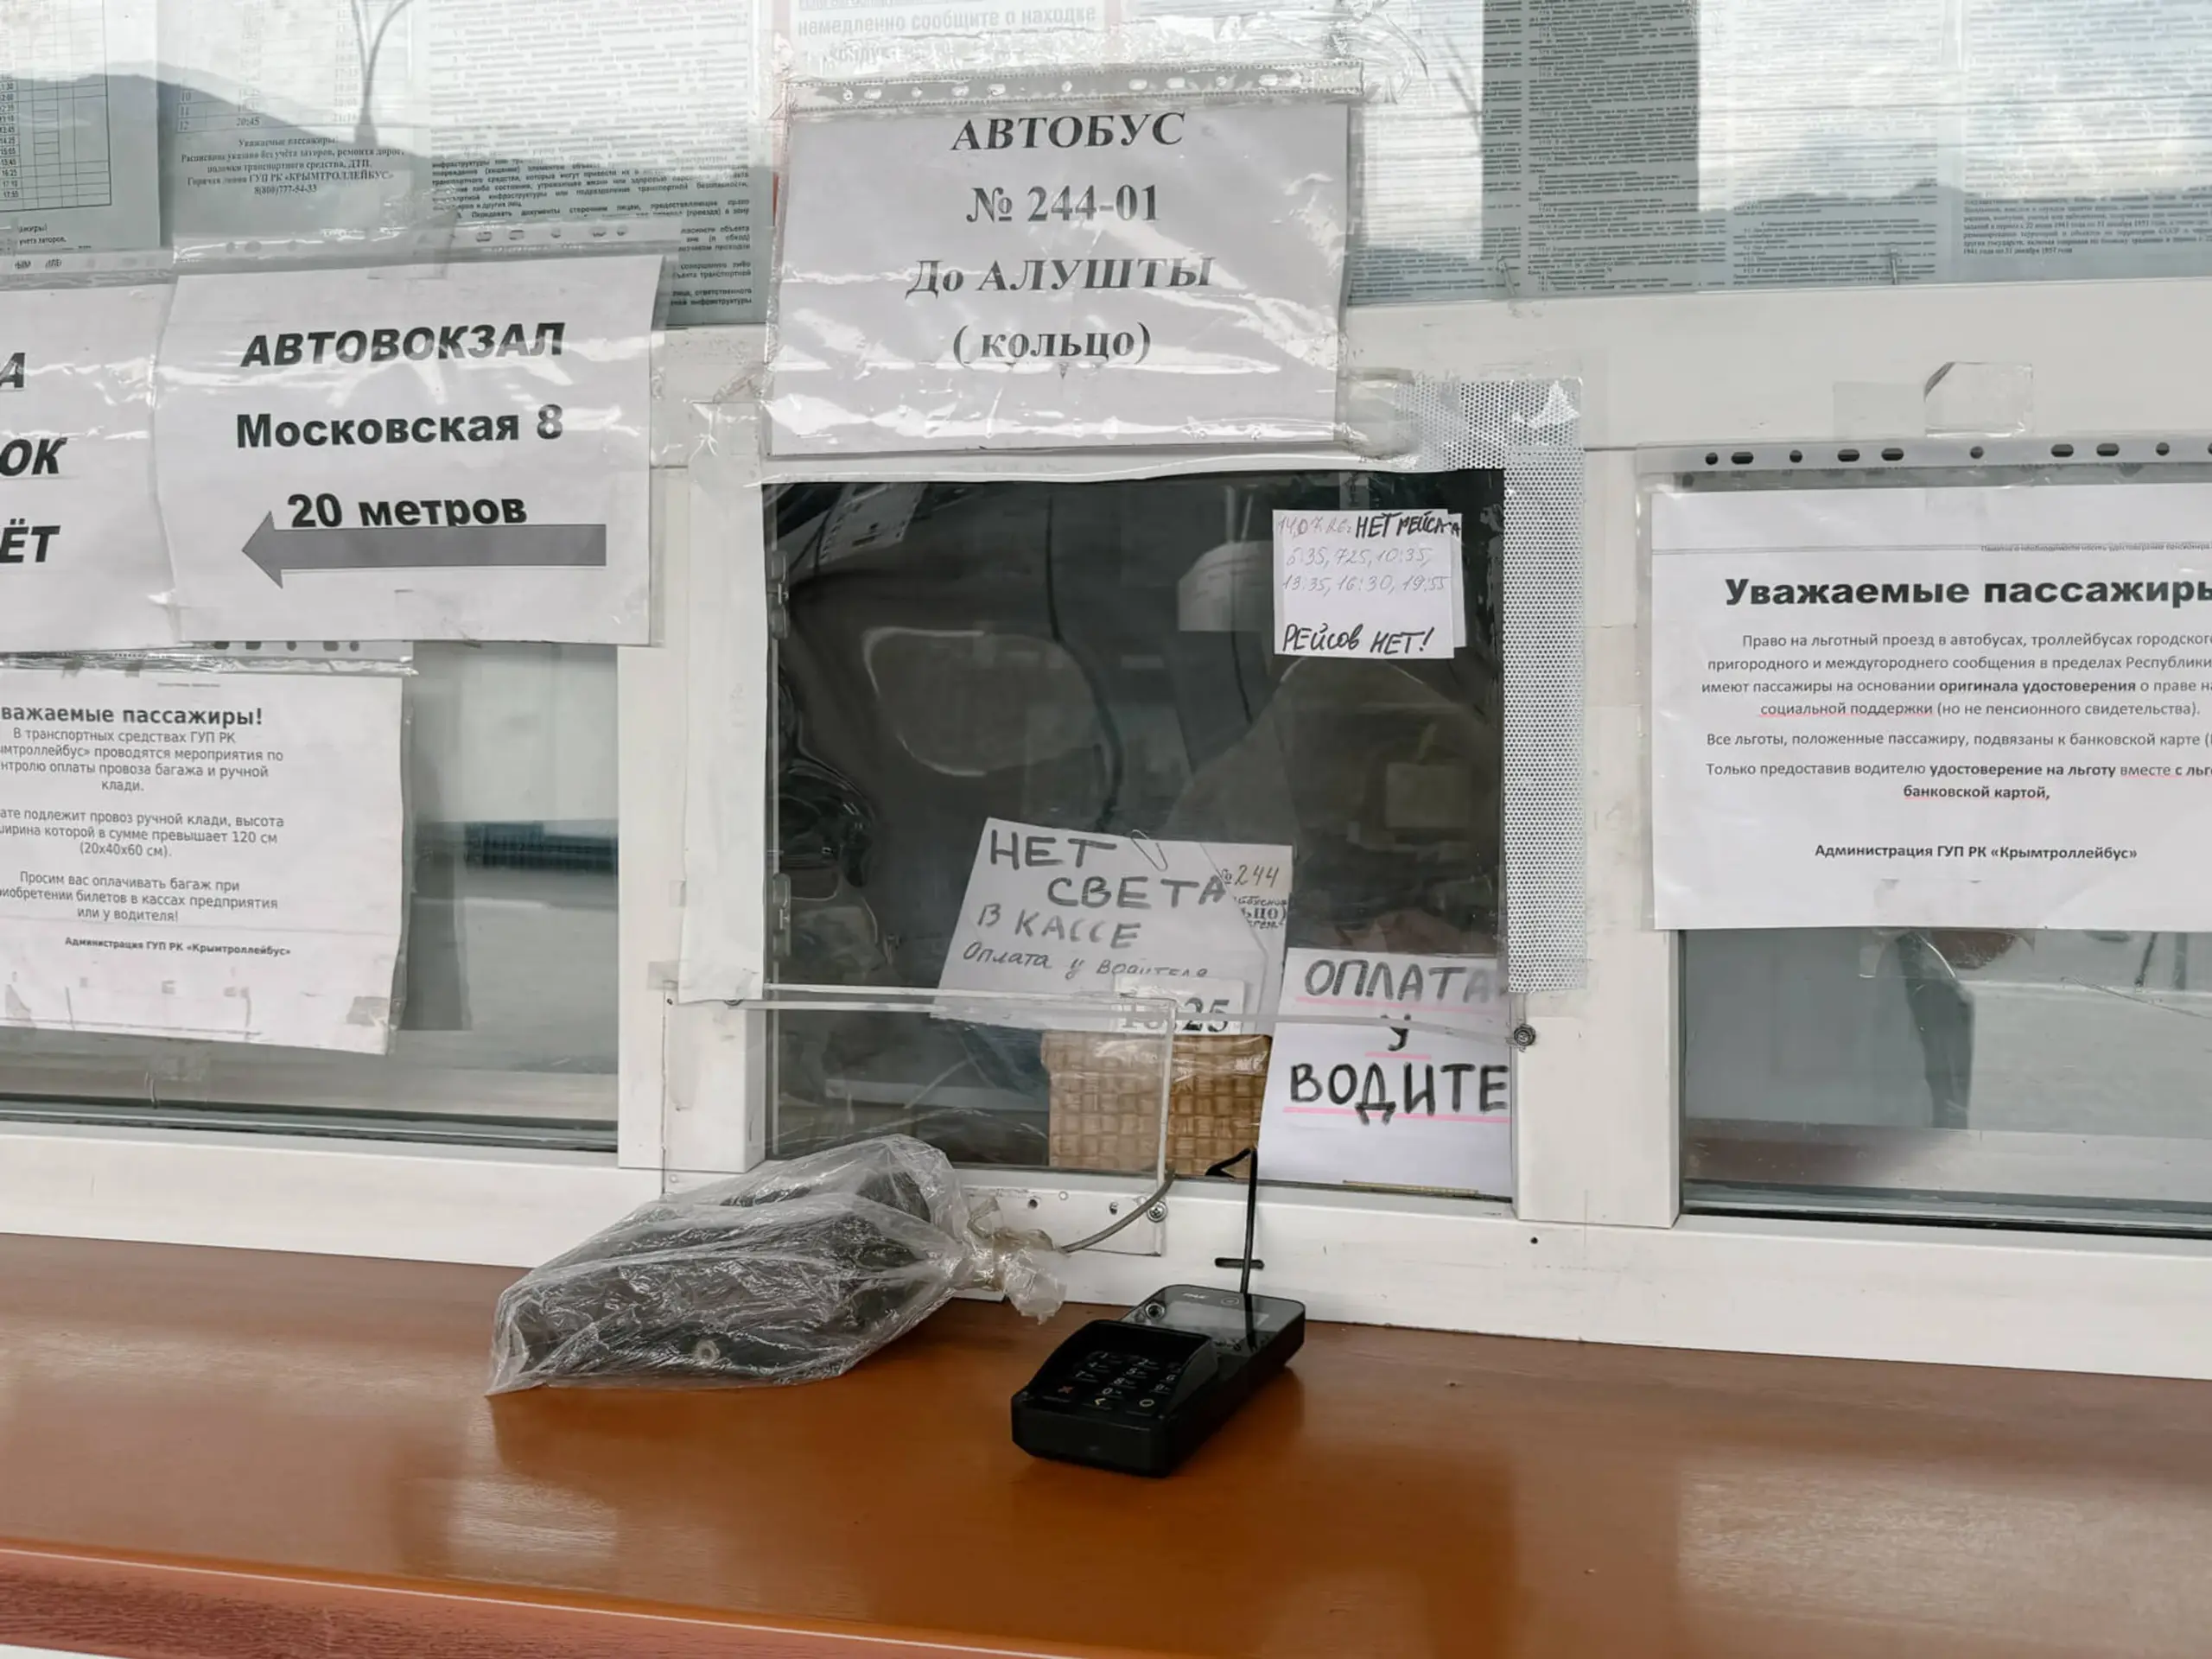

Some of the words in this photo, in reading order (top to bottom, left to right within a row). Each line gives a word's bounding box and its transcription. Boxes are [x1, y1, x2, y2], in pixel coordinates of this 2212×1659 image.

[950, 111, 1185, 151] АВТОБУС
[966, 186, 1013, 223] №
[1027, 183, 1160, 223] 244-01
[906, 259, 964, 300] До
[977, 257, 1217, 291] АЛУШТЫ
[240, 322, 565, 367] АВТОВОКЗАЛ
[237, 413, 519, 448] Московская
[537, 404, 563, 440] 8
[288, 493, 342, 529] 20
[359, 498, 528, 527] метров
[1356, 512, 1402, 538] НЕТ
[1726, 578, 1969, 606] Уважаемые
[1370, 626, 1434, 655] НЕТ!
[1743, 634, 1787, 650] Право
[1790, 637, 1807, 647] на
[1811, 634, 1878, 650] льготный
[1882, 637, 1935, 650] проезд
[1939, 636, 1946, 646] в
[1949, 632, 2026, 649] автобусах,
[2032, 632, 2133, 650] троллейбусах
[1707, 658, 1808, 672] пригородного
[1813, 659, 1821, 669] и
[1825, 657, 1948, 671] междугороднего
[1953, 656, 2036, 671] сообщения
[2040, 658, 2047, 669] в
[2052, 658, 2121, 672] пределах
[2126, 656, 2212, 671] Республики
[1701, 683, 1749, 694] имеют
[1753, 681, 1832, 695] пассажиры
[1836, 682, 1853, 692] на
[1857, 680, 1936, 692] основании
[1939, 681, 2018, 695] оригинала
[2023, 680, 2136, 696] удостоверения
[2140, 682, 2149, 691] о
[2154, 681, 2196, 695] праве
[2, 706, 114, 723] важаемые
[123, 708, 263, 728] пассажиры!
[1760, 702, 1847, 716] социальной
[1850, 703, 1933, 716] поддержки
[1937, 702, 1960, 717] (но
[1964, 704, 1982, 715] не
[1986, 703, 2081, 715] пенсионного
[2085, 701, 2200, 718] свидетельства).
[13, 728, 22, 739] В
[25, 730, 114, 743] транспортных
[118, 731, 187, 744] средствах
[190, 732, 215, 744] ГУП
[219, 733, 236, 744] РК
[1707, 734, 1731, 745] Все
[1735, 734, 1788, 747] льготы,
[1792, 734, 1884, 745] положенные
[1888, 734, 1969, 748] пассажиру,
[1974, 735, 2054, 747] подвязаны
[2058, 737, 2066, 746] к
[2069, 734, 2155, 747] банковской
[2159, 736, 2201, 748] карте
[94, 748, 171, 761] проводятся
[175, 750, 264, 763] мероприятия
[267, 753, 283, 762] по
[50, 763, 95, 775] оплаты
[99, 764, 151, 777] провоза
[155, 764, 204, 777] багажа
[207, 767, 216, 777] и
[219, 765, 269, 779] ручной
[1706, 763, 1756, 775] Только
[1760, 764, 1851, 777] предоставив
[1854, 765, 1925, 777] водителю
[1929, 765, 2043, 778] удостоверение
[2046, 766, 2064, 776] на
[2068, 766, 2116, 779] льготу
[2120, 766, 2171, 776] вместе
[2175, 766, 2182, 776] с
[101, 780, 144, 793] клади.
[1904, 785, 1989, 798] банковской
[1995, 786, 2050, 800] картой,
[24, 810, 86, 823] подлежит
[90, 812, 133, 825] провоз
[137, 814, 183, 827] ручной
[187, 816, 232, 828] клади,
[235, 817, 284, 827] высота
[45, 825, 95, 840] которой
[99, 829, 106, 838] в
[109, 830, 149, 842] сумме
[152, 830, 228, 844] превышает
[232, 831, 257, 843] 120
[260, 834, 278, 843] см
[146, 844, 172, 857] см).
[990, 829, 1118, 870] НЕТ
[1815, 844, 1933, 858] Администрация
[1937, 846, 1964, 857] ГУП
[1968, 846, 1986, 857] РК
[1991, 846, 2137, 861] «Крымтроллейбус»
[20, 871, 65, 887] Просим
[68, 875, 89, 887] вас
[92, 876, 167, 890] оплачивать
[170, 877, 212, 891] багаж
[215, 880, 240, 893] при
[1235, 864, 1279, 888] 244
[76, 890, 127, 904] билетов
[130, 894, 138, 905] в
[142, 895, 186, 906] кассах
[189, 897, 278, 910] предприятия
[1047, 874, 1227, 909] СВЕТА
[77, 908, 99, 918] или
[103, 910, 111, 922] у
[114, 909, 178, 922] водителя!
[1015, 910, 1141, 950] КАССЕ
[65, 937, 143, 950] Администрация
[146, 939, 167, 950] ГУП
[169, 942, 183, 951] РК
[187, 943, 290, 957] «Крымтроллейбус»
[963, 941, 1052, 969] Оплата
[1070, 958, 1087, 980] у
[1305, 959, 1491, 1003] ОПЛАТА
[1290, 1062, 1509, 1125] ВОДИТЕ
